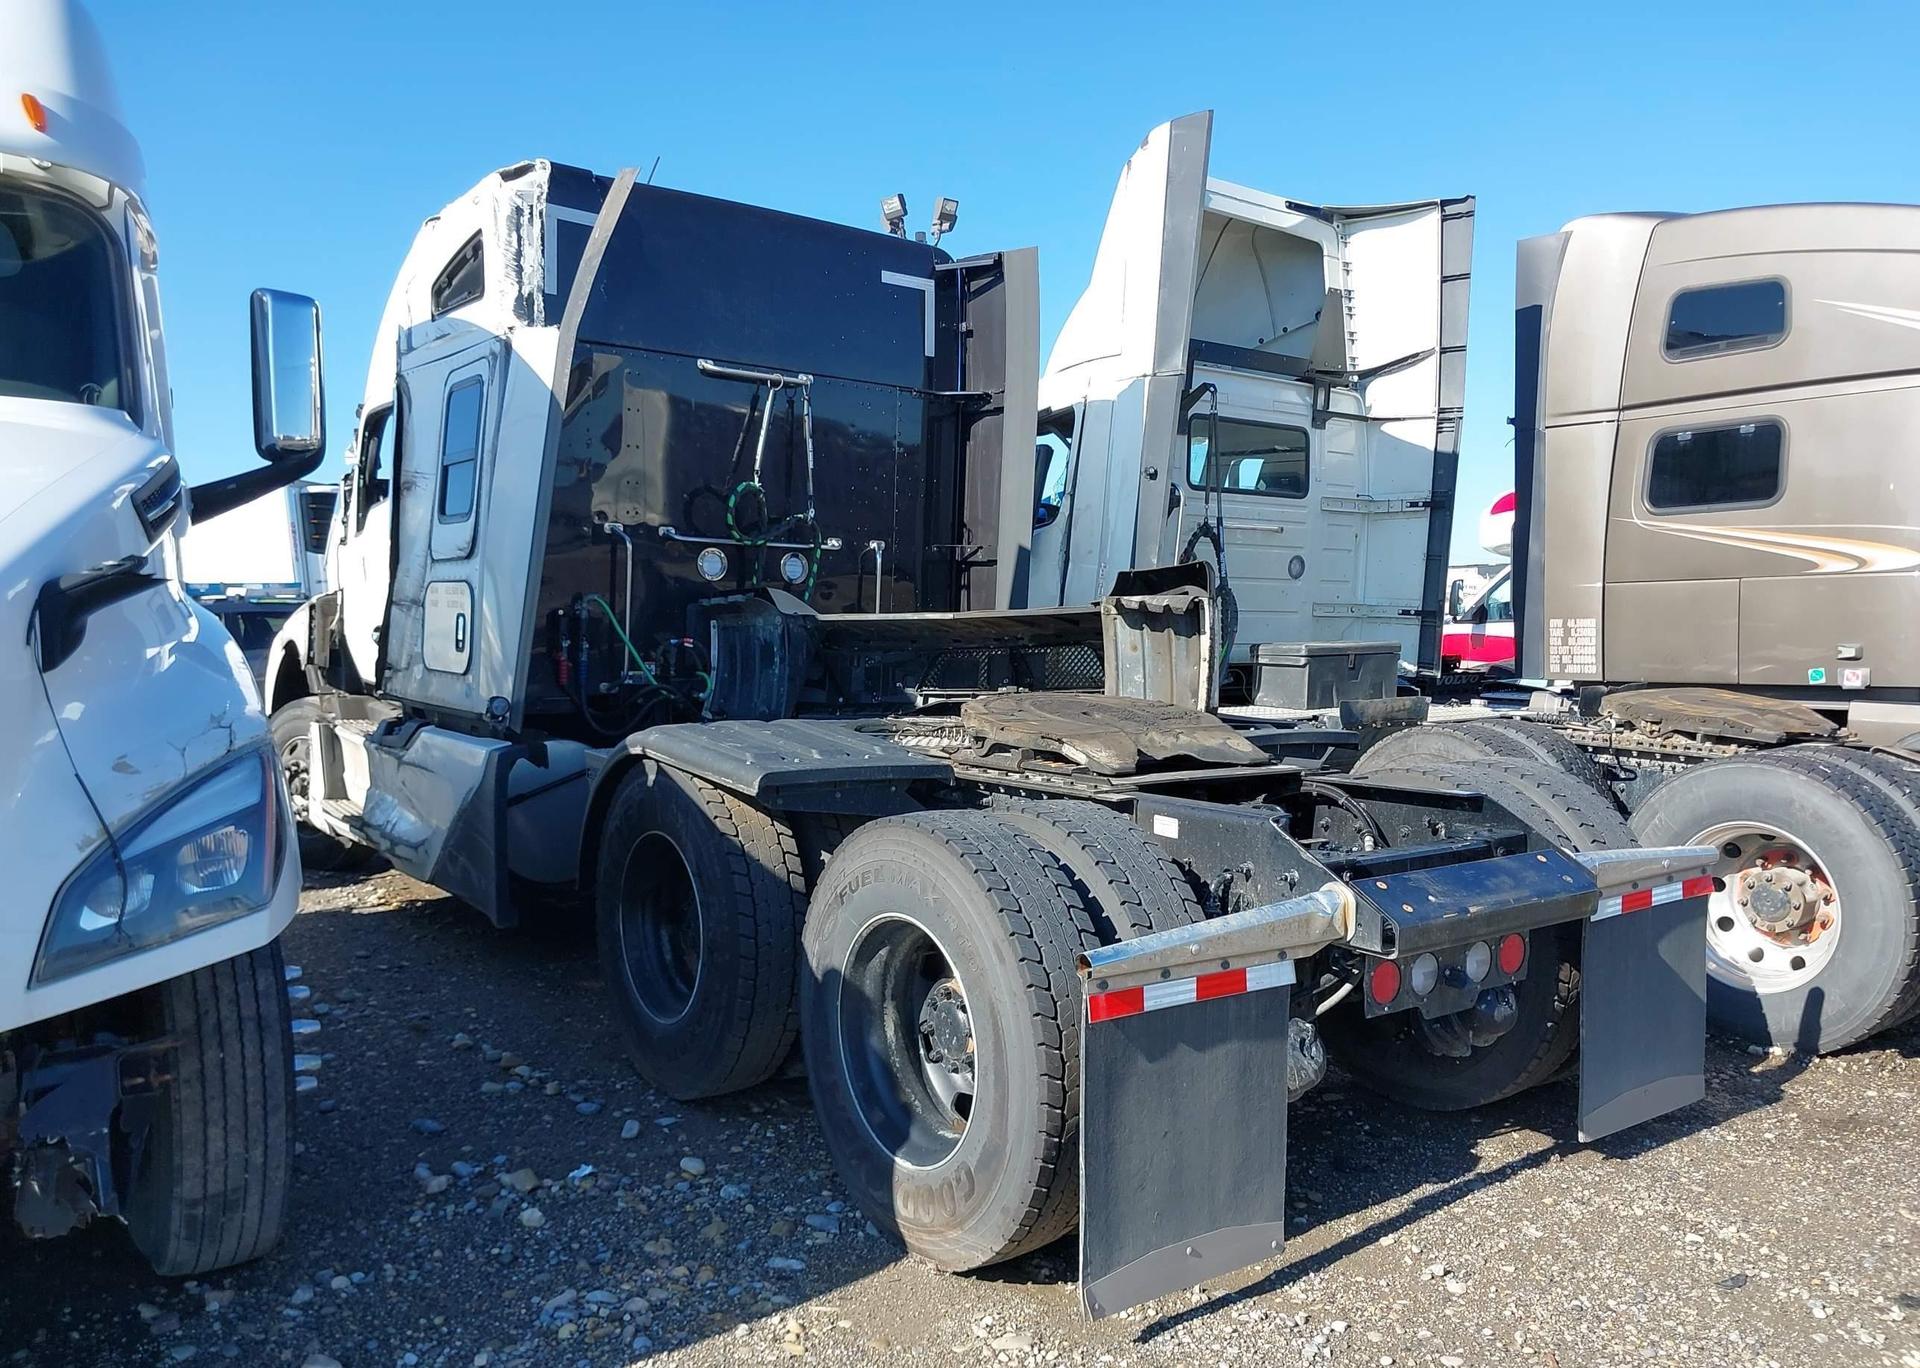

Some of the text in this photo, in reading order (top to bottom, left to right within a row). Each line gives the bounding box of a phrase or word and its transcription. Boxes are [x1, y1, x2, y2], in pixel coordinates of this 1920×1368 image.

[1549, 628, 1564, 636] TARE
[1549, 636, 1562, 645] USA
[1436, 673, 1480, 686] VOLVO
[838, 867, 884, 906] FUEL
[890, 872, 942, 907] MAX
